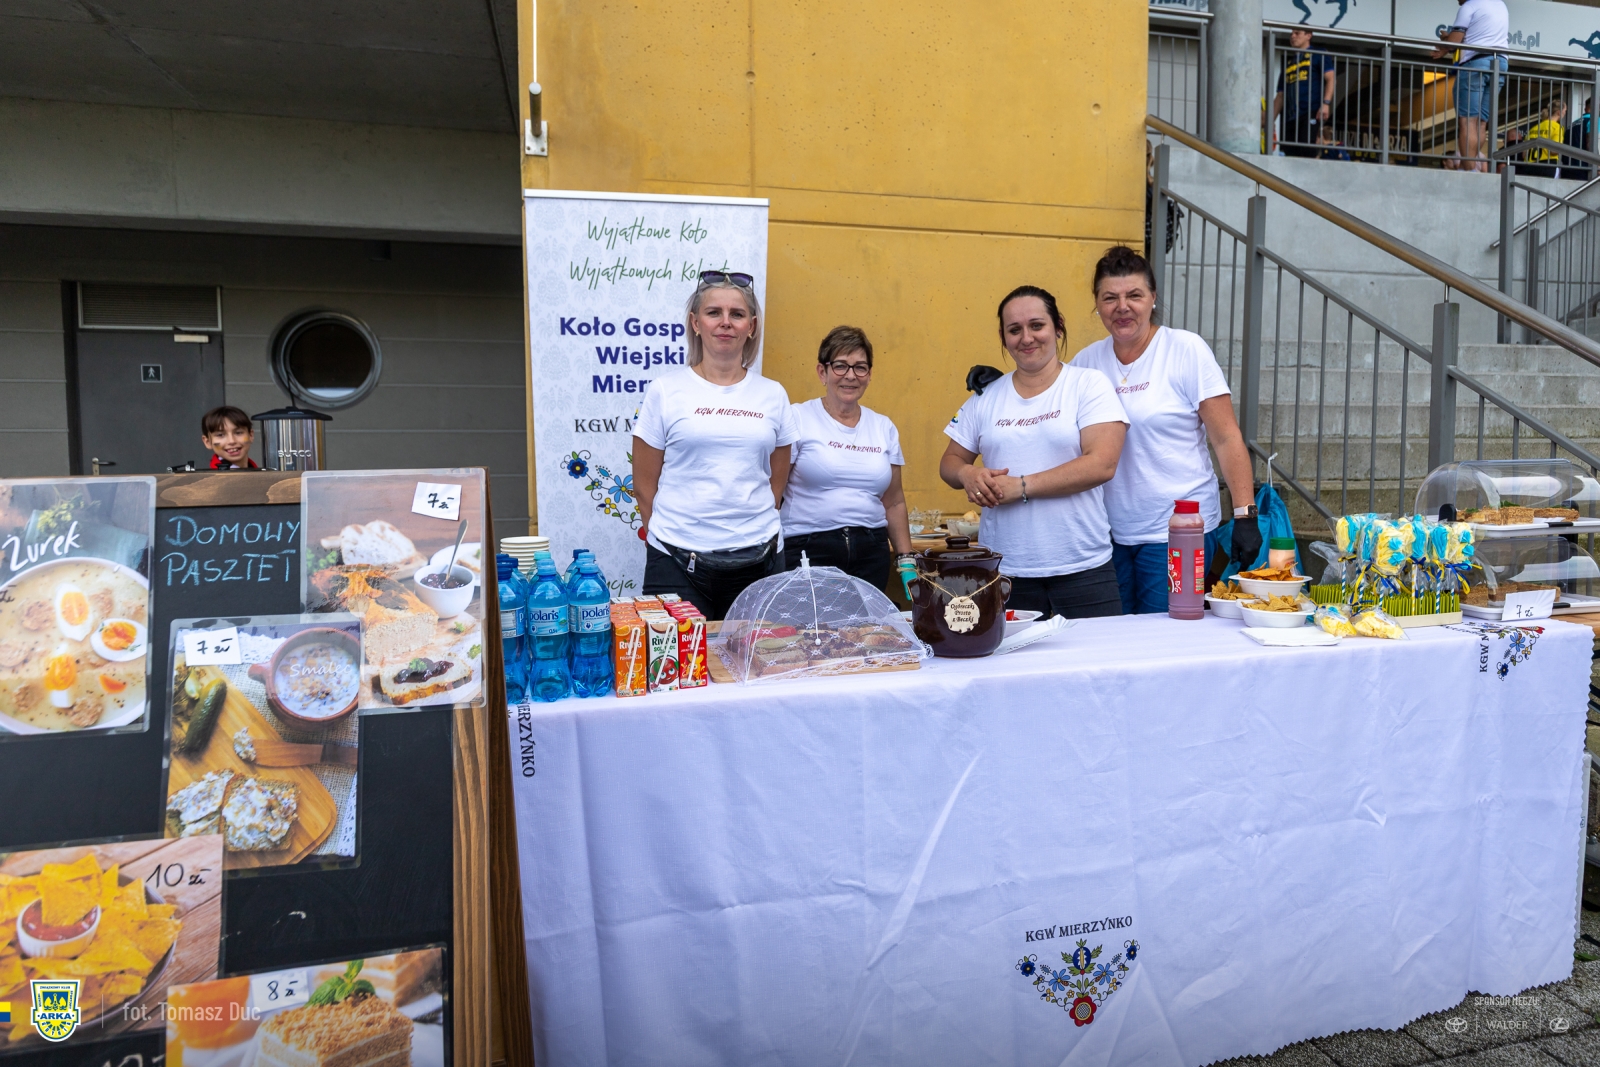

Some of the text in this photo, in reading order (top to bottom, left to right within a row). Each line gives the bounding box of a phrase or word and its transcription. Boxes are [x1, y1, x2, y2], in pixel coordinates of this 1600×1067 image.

[587, 216, 708, 250] Wyjątkowe Koło
[569, 256, 672, 291] Wyjątkowych
[560, 316, 686, 342] Koło Gosp
[595, 345, 685, 370] Wiejski
[574, 415, 620, 433] KGW
[694, 407, 764, 419] KGW MIERZYNKO
[994, 409, 1061, 428] KGW MIERZYNKO
[278, 449, 312, 458] BURCO
[828, 440, 882, 454] KGW MIERZYNKO
[164, 515, 300, 547] DOMOWY
[1, 520, 81, 572] Żurek
[160, 549, 297, 587] PASZTET
[290, 661, 352, 678] Smalec
[1479, 643, 1489, 673] KGW
[145, 863, 184, 889] 10
[1025, 916, 1133, 942] KGW MIERZYNKO
[267, 980, 279, 1001] 8
